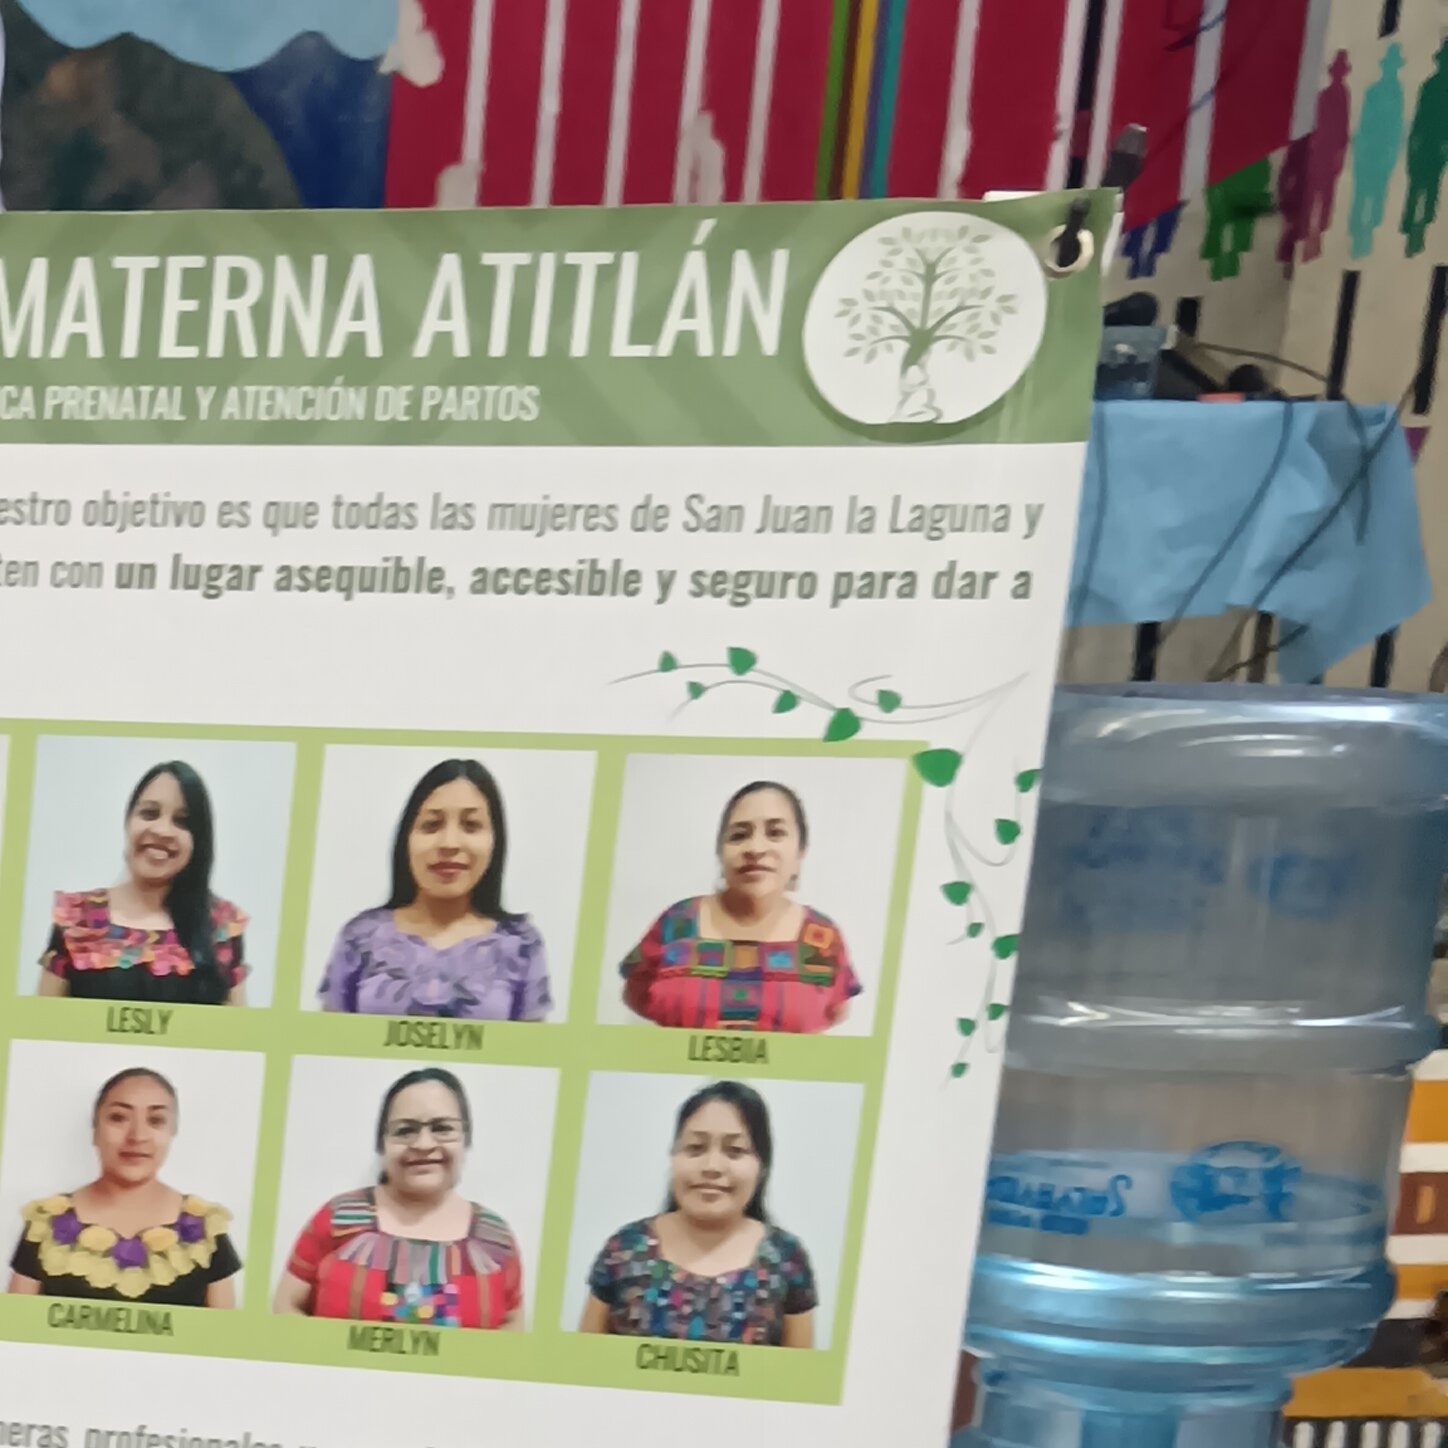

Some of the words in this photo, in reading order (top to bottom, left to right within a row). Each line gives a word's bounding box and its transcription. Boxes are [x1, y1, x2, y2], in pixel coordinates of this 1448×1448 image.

[413, 219, 789, 358] ATITLÁN
[44, 385, 185, 421] PRENATAL
[197, 386, 213, 421] Y
[221, 376, 366, 422] ATENCIÓN
[374, 387, 412, 422] DE
[420, 386, 540, 422] PARTOS
[82, 485, 204, 535] objetivo
[217, 496, 251, 526] es
[262, 496, 319, 536] que
[331, 488, 417, 528] todas
[429, 489, 475, 528] las
[487, 490, 618, 539] mujeres
[630, 491, 669, 530] de
[681, 491, 744, 531] San
[755, 492, 832, 532] Juan
[845, 493, 875, 532] la
[889, 493, 1010, 543] Laguna
[1021, 504, 1044, 544] y
[49, 557, 103, 587] con
[115, 558, 156, 588] un
[169, 550, 263, 599] lugar
[274, 553, 455, 601] asequible,
[469, 556, 641, 595] accesible
[656, 566, 677, 606] y
[688, 567, 817, 607] seguro
[829, 569, 916, 608] para
[932, 562, 998, 600] dar
[1010, 572, 1032, 601] a
[107, 1005, 173, 1037] LESLY
[383, 1018, 484, 1053] JOSELYN
[688, 1032, 769, 1066] LESBIA
[48, 1301, 174, 1338] CARMELINA
[347, 1324, 440, 1358] MERLYN
[636, 1343, 742, 1380] CHUSITA
